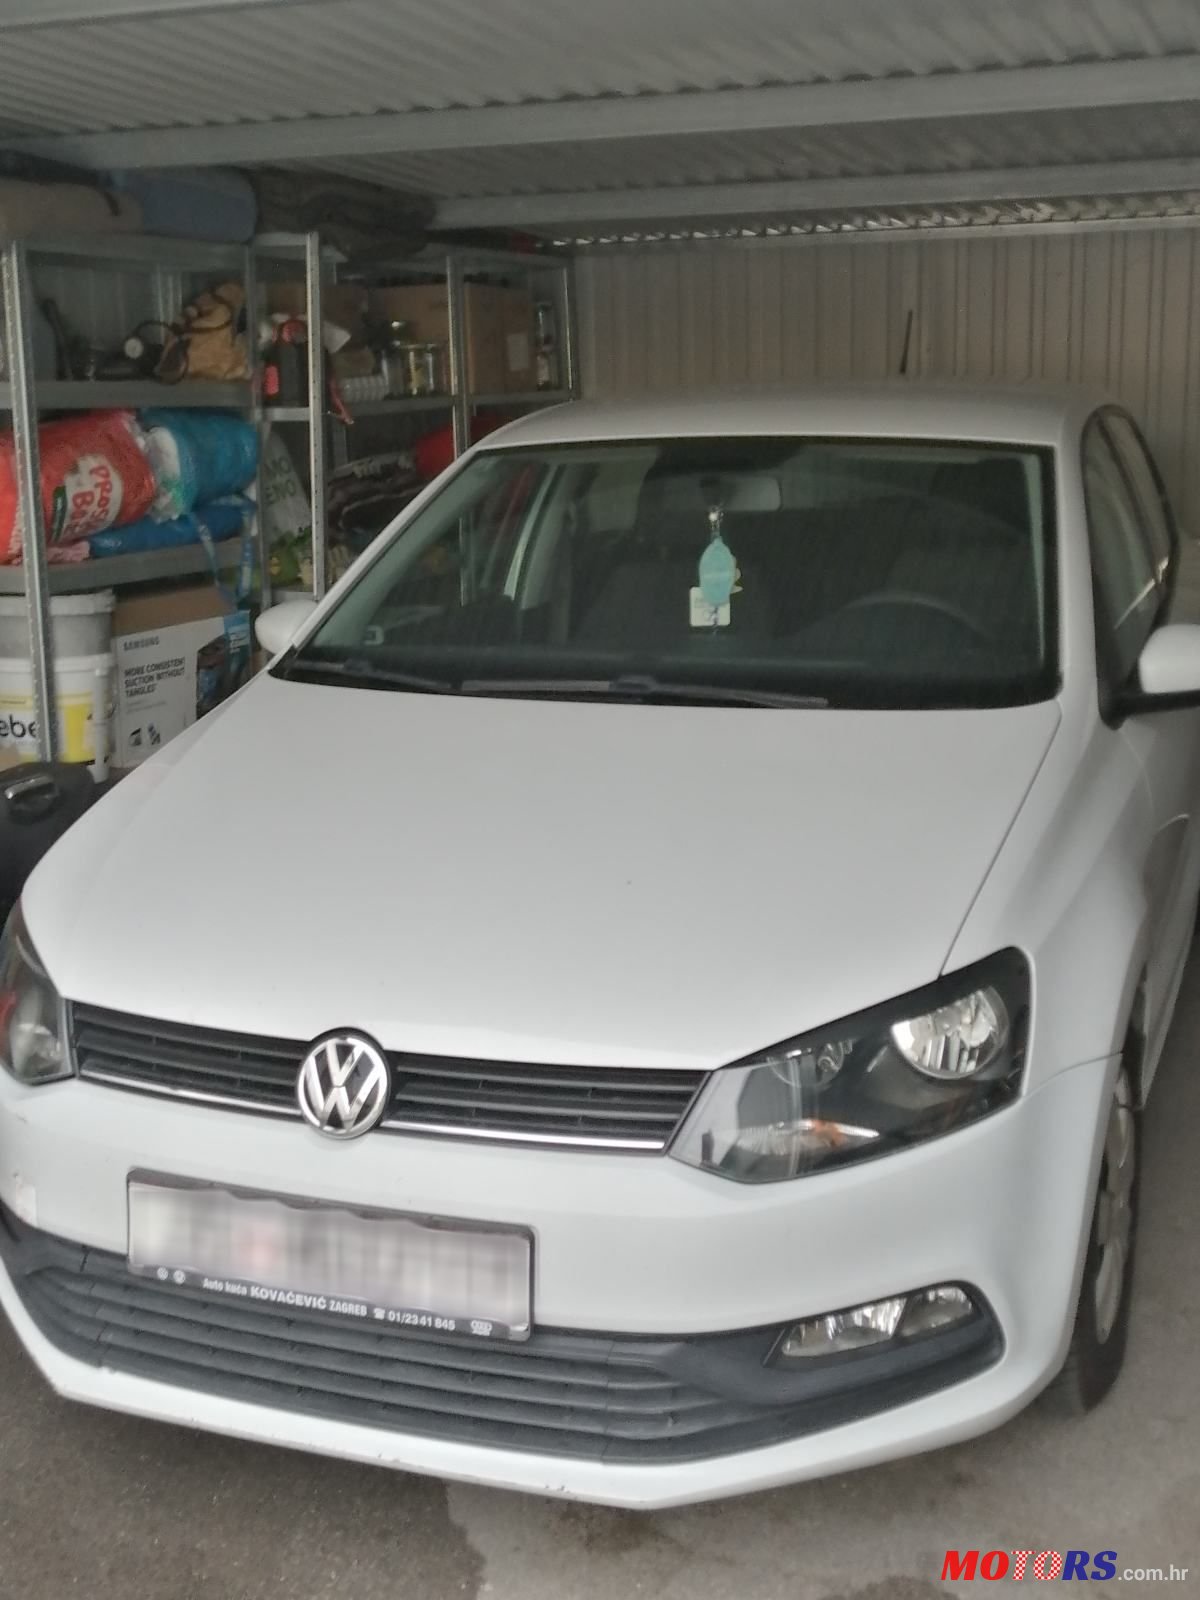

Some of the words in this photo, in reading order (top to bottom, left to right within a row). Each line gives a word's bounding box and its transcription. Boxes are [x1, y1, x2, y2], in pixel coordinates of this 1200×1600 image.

[124, 636, 160, 651] SAMSUNG
[124, 665, 145, 678] MORE
[146, 656, 186, 674] CONSISTENT
[124, 675, 154, 689] SUCTION
[156, 667, 185, 682] WITHOUT
[203, 1278, 224, 1292] Auto
[329, 1299, 368, 1317] ZAGREB
